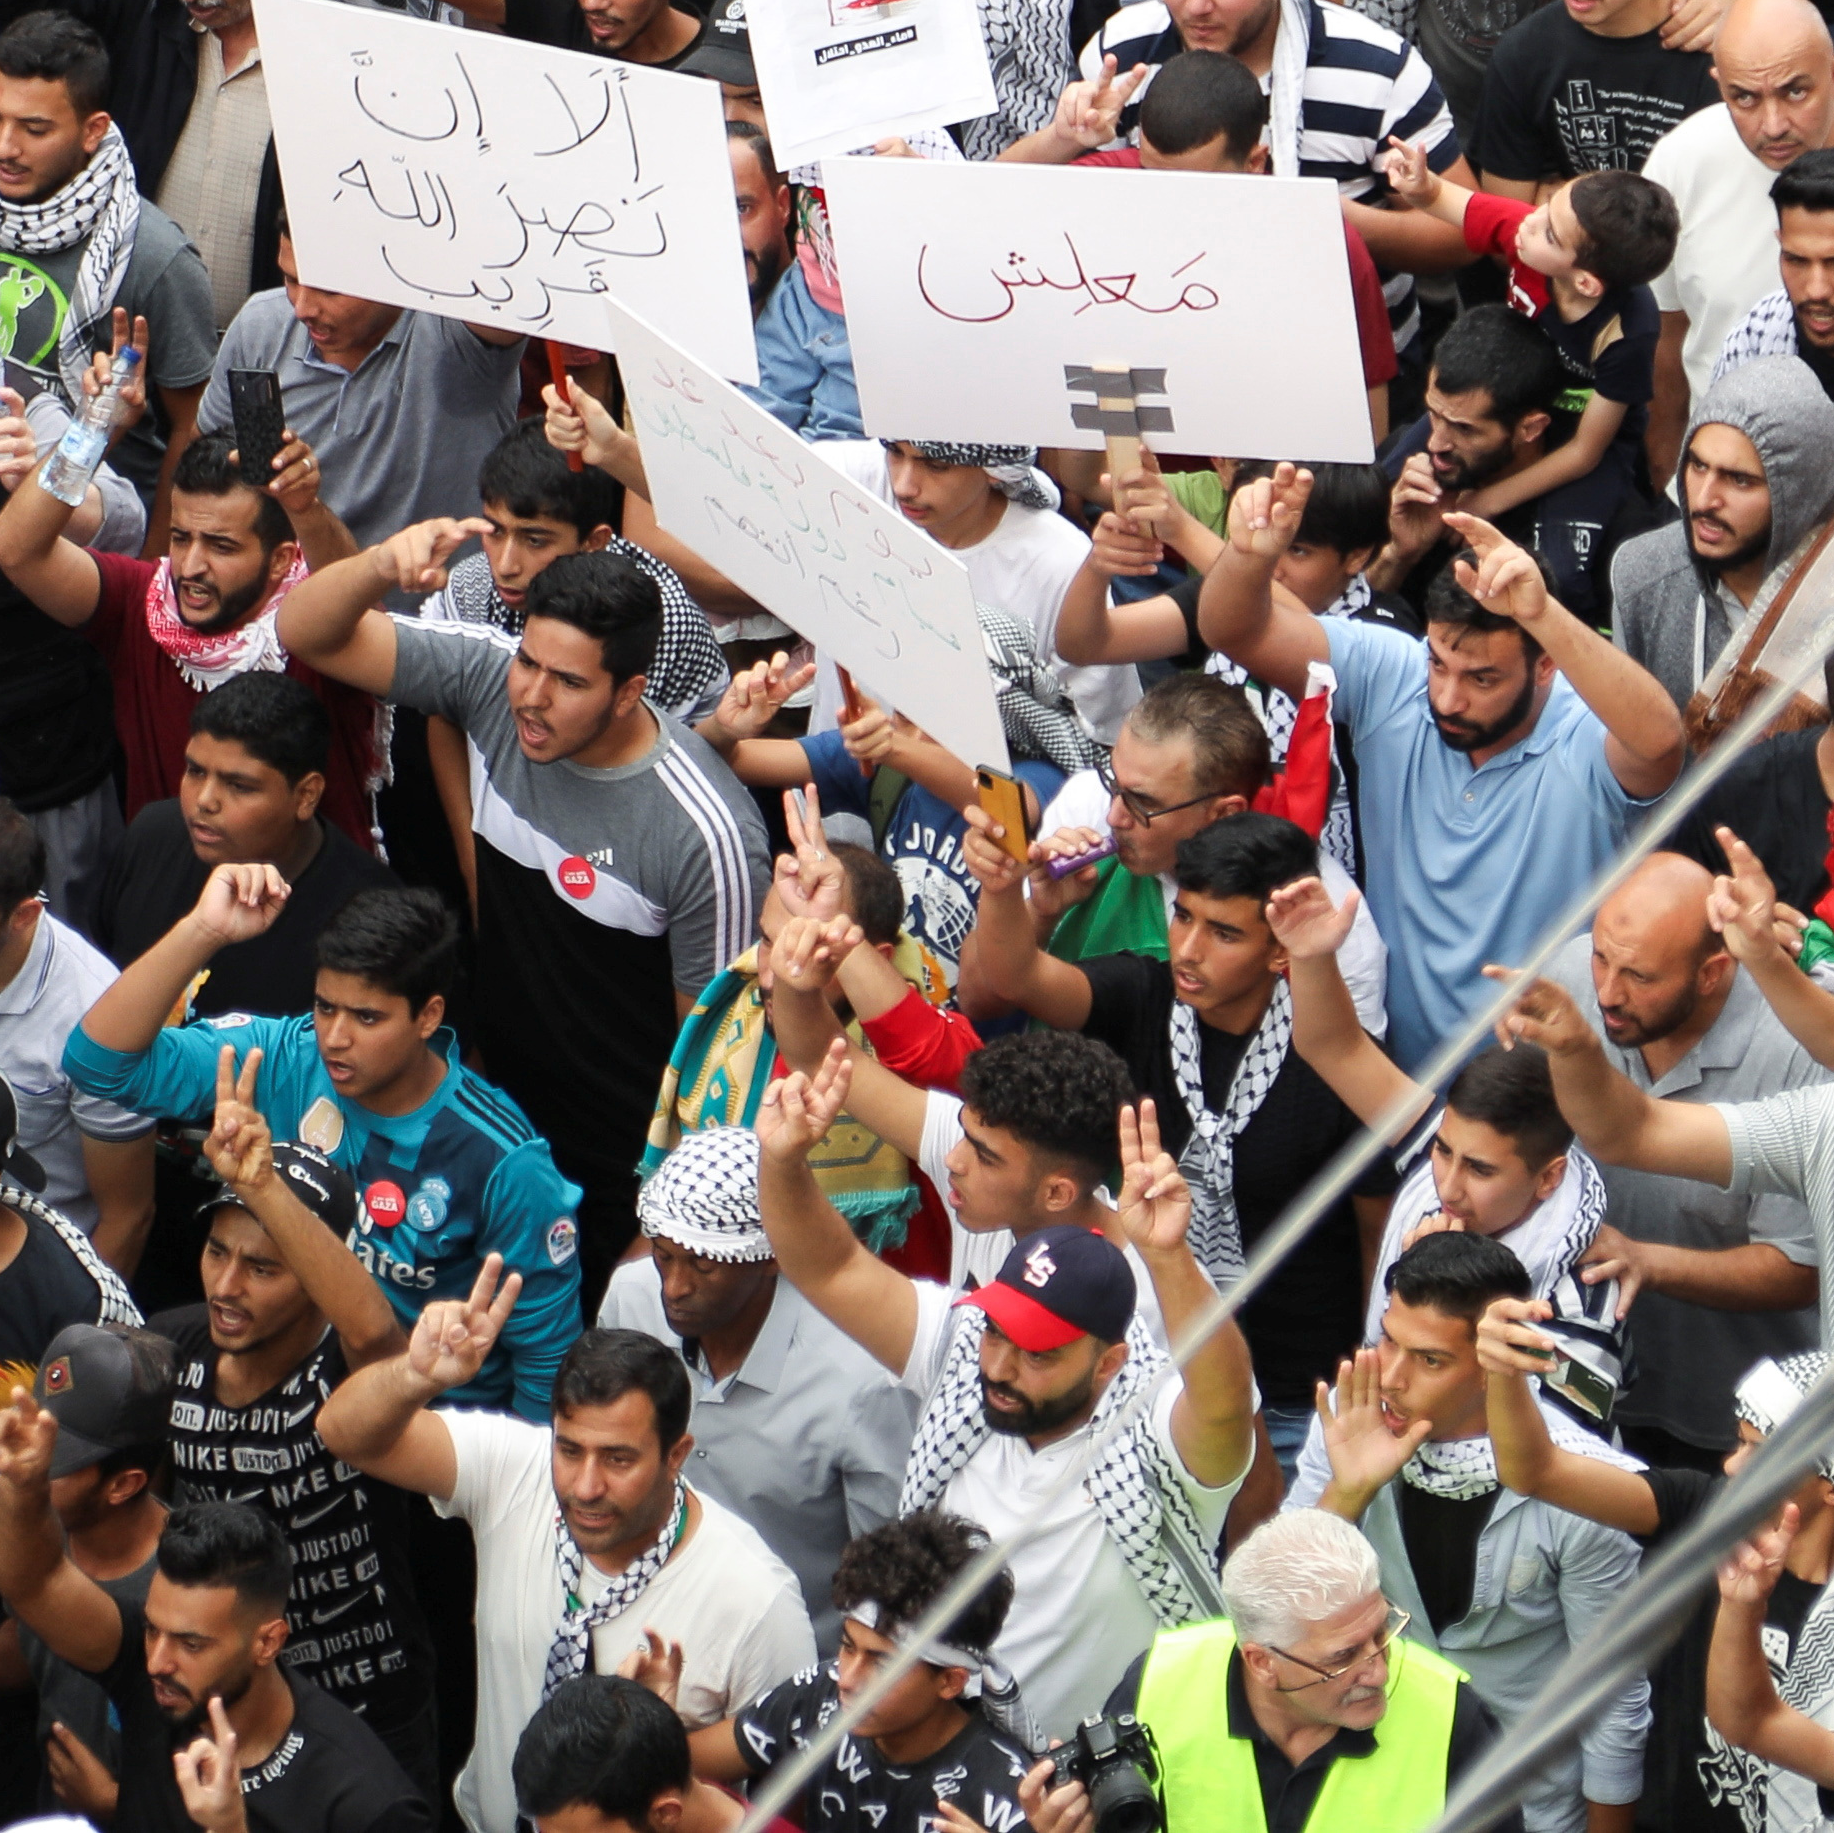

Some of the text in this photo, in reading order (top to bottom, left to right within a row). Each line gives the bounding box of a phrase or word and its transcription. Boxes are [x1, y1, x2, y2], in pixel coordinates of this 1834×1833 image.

[564, 874, 591, 885] GAZA
[370, 1200, 399, 1213] GAZA
[172, 1441, 227, 1472] NIKE
